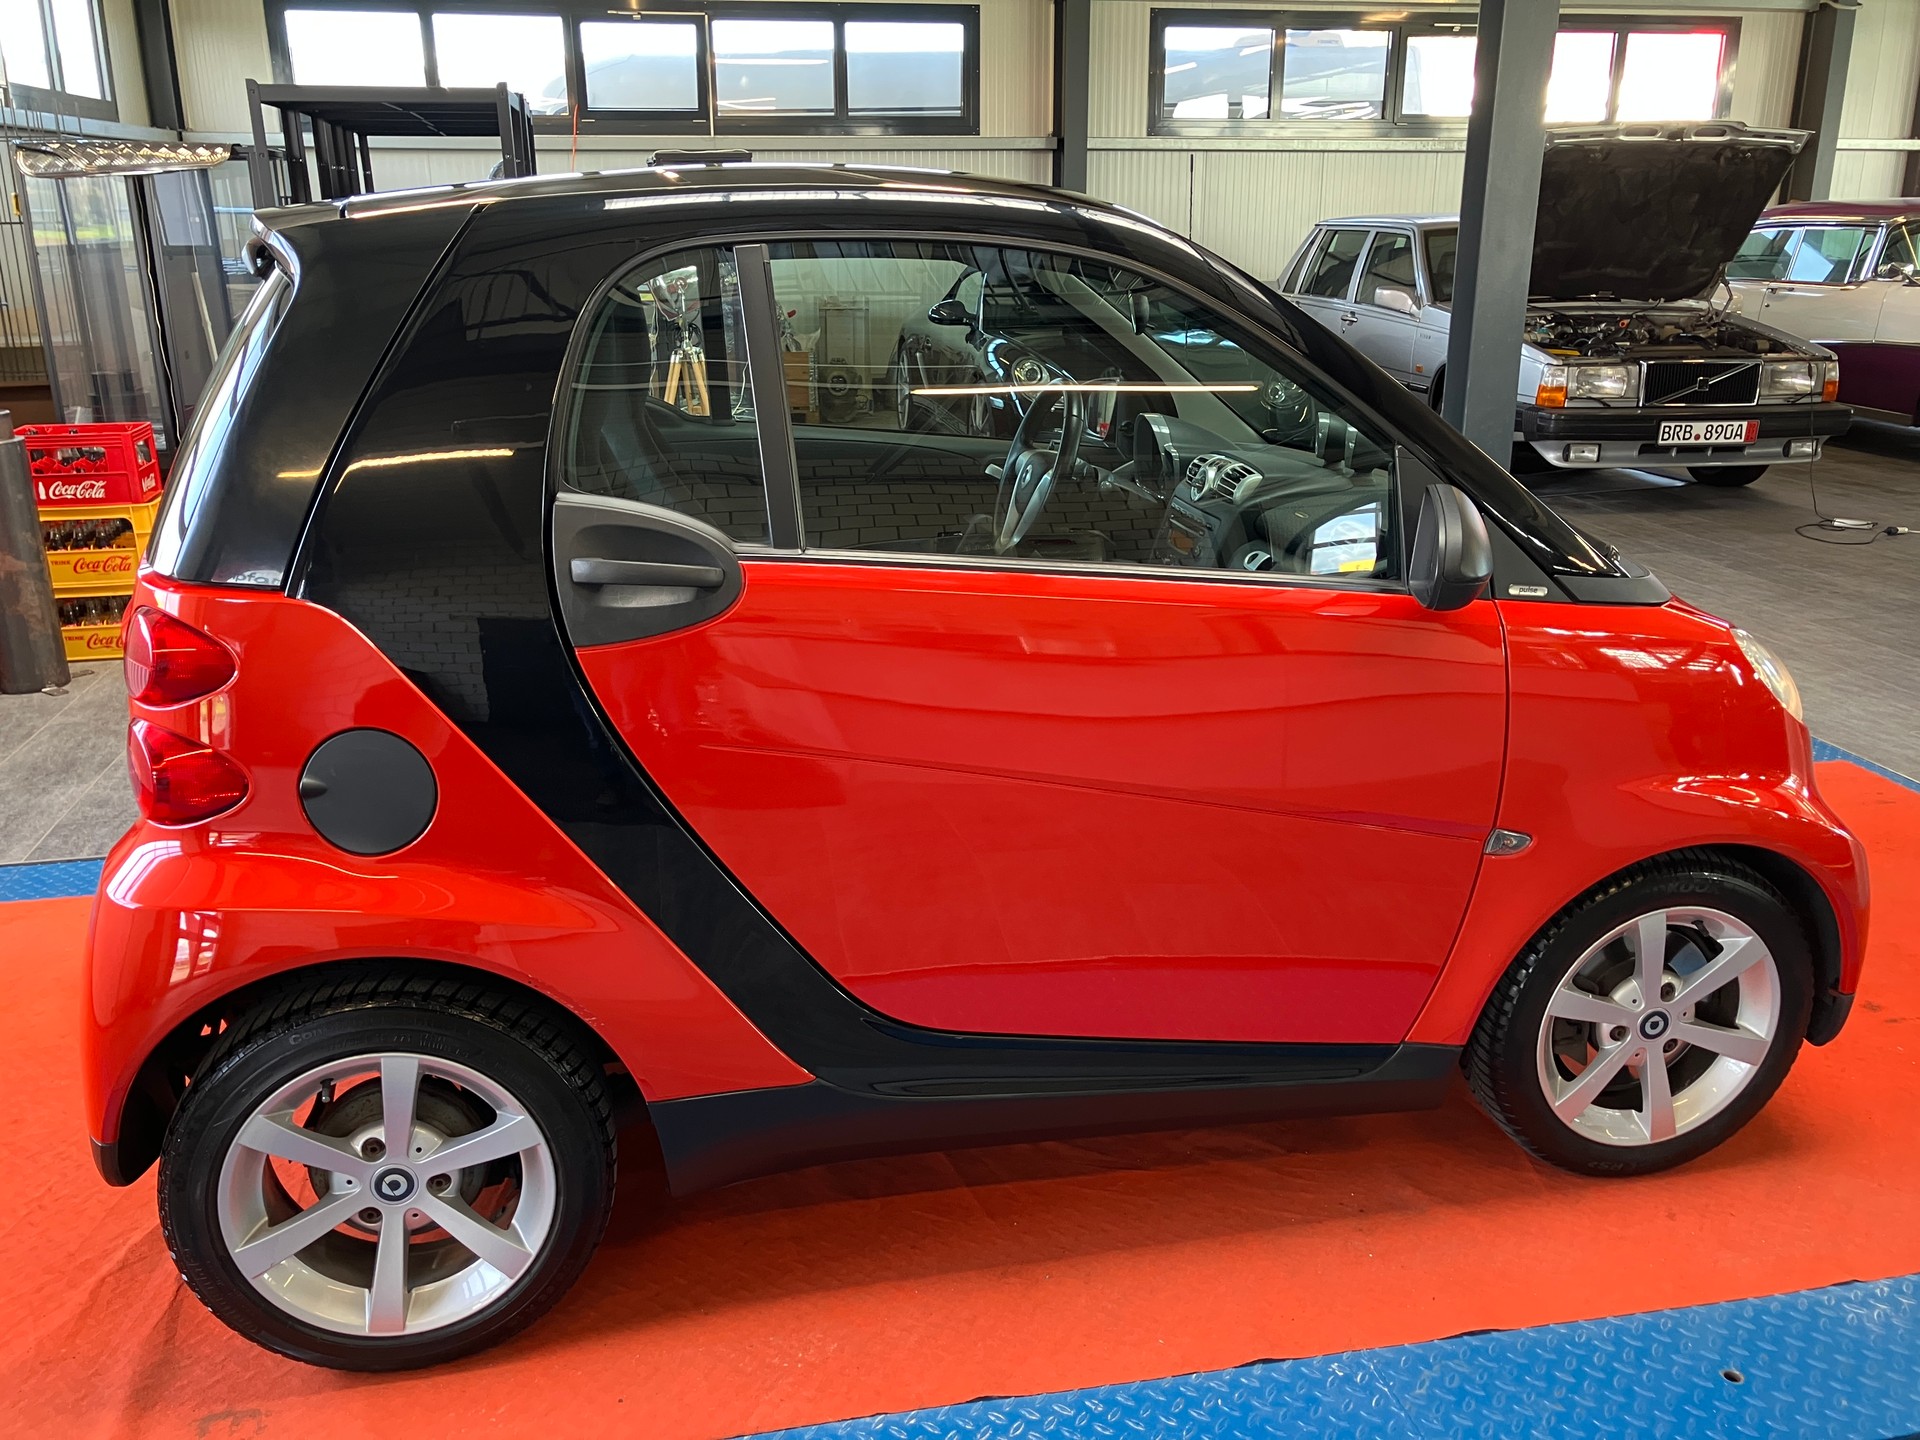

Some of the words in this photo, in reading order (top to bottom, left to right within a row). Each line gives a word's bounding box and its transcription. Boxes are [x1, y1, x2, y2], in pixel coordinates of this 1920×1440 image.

[1661, 424, 1693, 441] BRB
[1703, 423, 1743, 441] 890A
[49, 480, 106, 499] Coca-Cola
[73, 555, 132, 574] Coca-Cola
[1519, 585, 1538, 596] pulse
